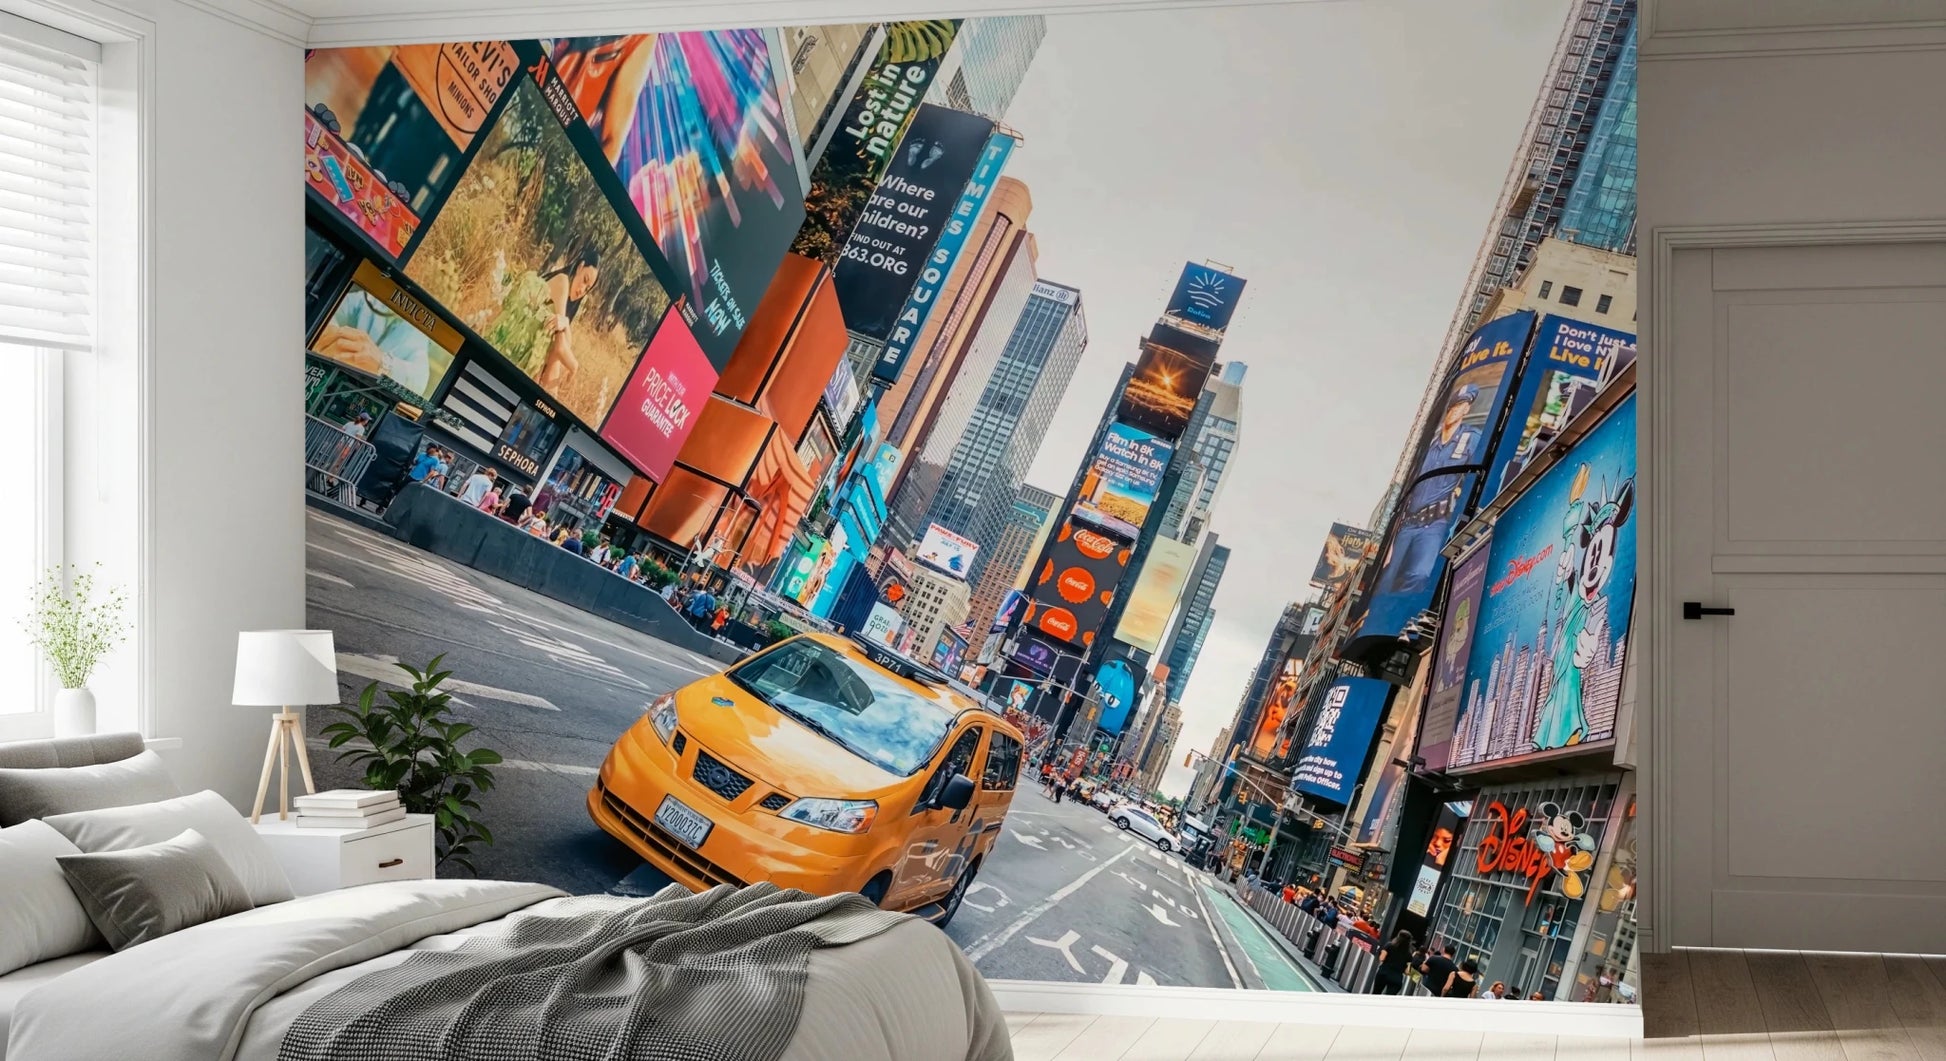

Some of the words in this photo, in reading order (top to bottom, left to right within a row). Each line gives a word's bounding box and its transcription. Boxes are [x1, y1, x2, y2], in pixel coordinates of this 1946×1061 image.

[451, 41, 480, 81] TAILOR
[478, 78, 497, 104] SHO
[471, 41, 511, 88] EVI'S
[447, 81, 475, 119] MINIONS
[544, 87, 570, 126] MARQUIS
[551, 77, 579, 120] MARRIOTT
[845, 88, 888, 139] Lost
[871, 63, 901, 88] in
[866, 65, 926, 157] nature
[880, 174, 936, 201] Where
[947, 146, 1002, 236] TIMES
[869, 193, 895, 209] are
[897, 200, 928, 219] our
[861, 210, 929, 240] hildren?
[850, 232, 870, 244] FIND
[871, 238, 893, 251] OUT
[892, 245, 906, 256] AT
[710, 258, 731, 301] TICKETS
[1033, 283, 1055, 297] lianz
[390, 289, 436, 332] INVICTA
[704, 297, 732, 337] NOW
[883, 249, 950, 365] SQUARE
[1492, 341, 1513, 358] it.
[1554, 335, 1560, 345] I
[1562, 337, 1592, 352] love
[1558, 323, 1597, 342] Don't
[1549, 346, 1590, 368] Live
[535, 399, 557, 419] SEPHORA
[642, 367, 672, 408] PRICE
[664, 393, 690, 430] LOCK
[641, 398, 674, 438] GUARANTEE
[497, 444, 540, 478] SEPHORA
[1104, 442, 1138, 461] Watch
[1138, 452, 1149, 465] in
[1149, 458, 1165, 471] 8K
[1108, 432, 1129, 447] Film
[1129, 440, 1140, 452] in
[1140, 444, 1155, 457] 8K
[873, 652, 901, 674] 3P71
[1333, 770, 1343, 780] to
[661, 804, 702, 840] Y200037C
[1477, 801, 1551, 906] Disney
